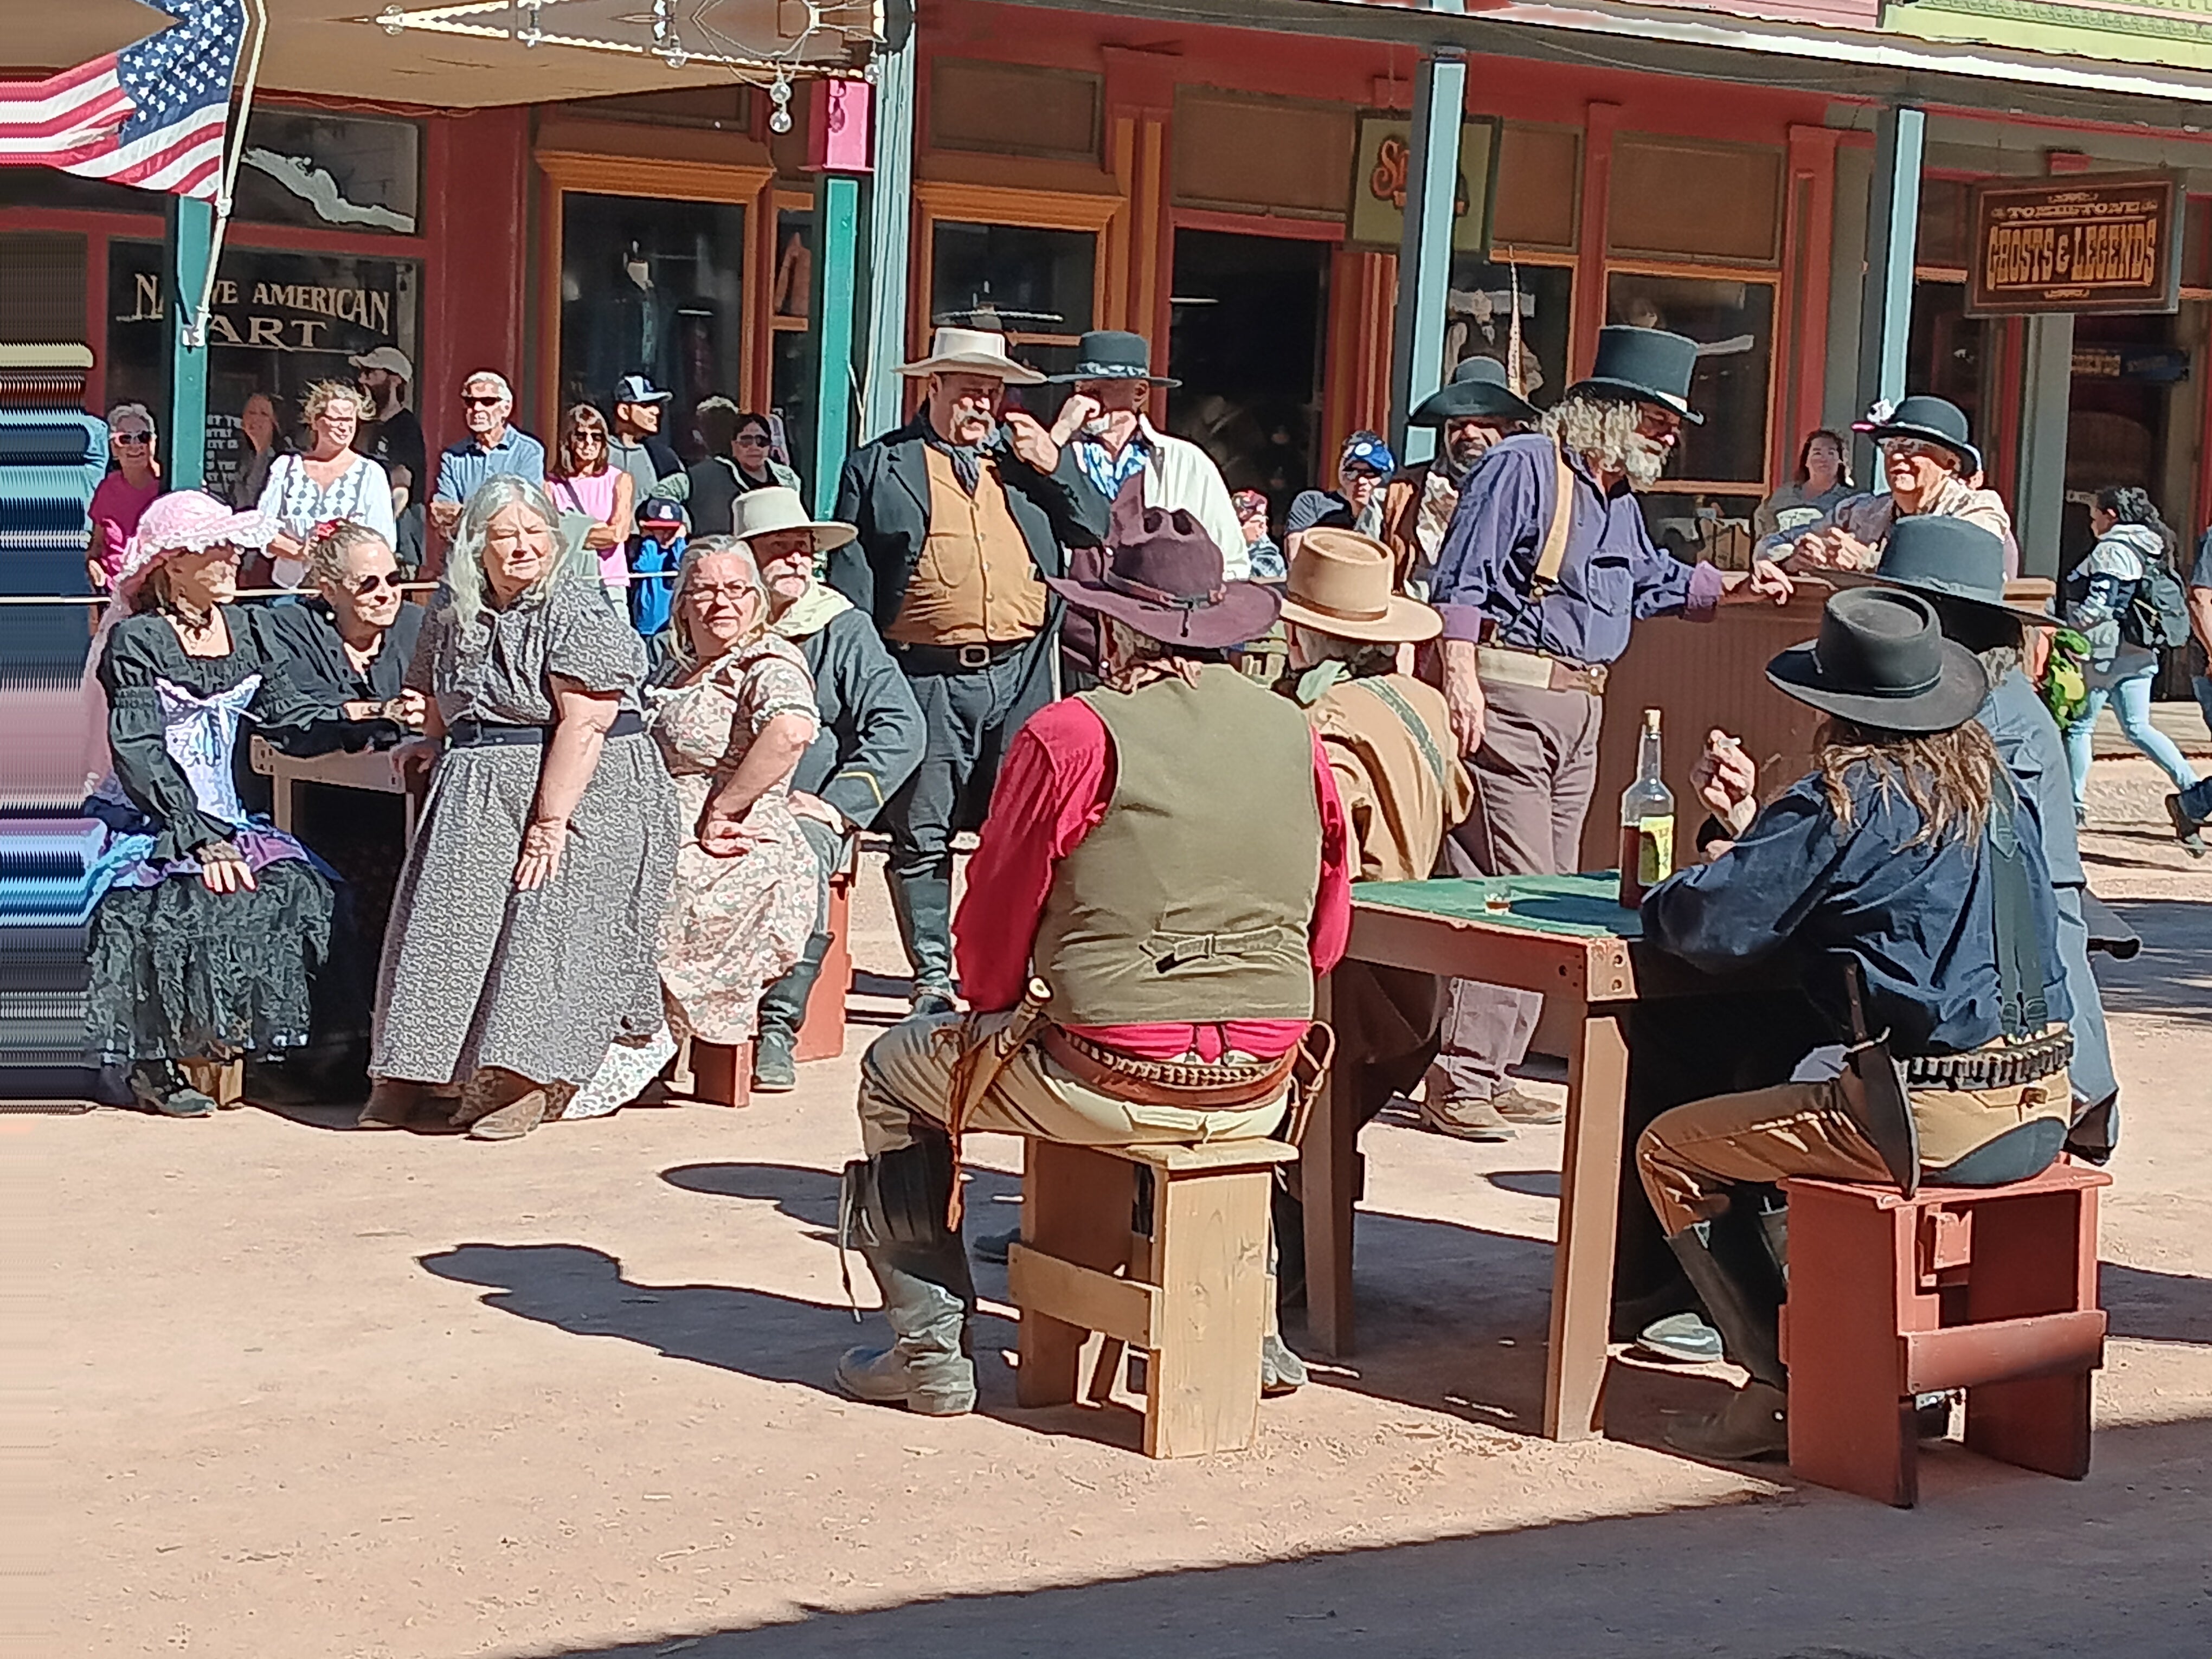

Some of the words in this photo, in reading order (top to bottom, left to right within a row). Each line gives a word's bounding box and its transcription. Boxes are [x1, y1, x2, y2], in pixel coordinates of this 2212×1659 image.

[2007, 202, 2140, 218] TOTONE
[1986, 226, 2054, 291] GHOSTS
[2056, 234, 2070, 273] &
[2070, 218, 2157, 287] LEGENDS
[252, 282, 389, 335] AMERICAN
[209, 314, 328, 352] ART
